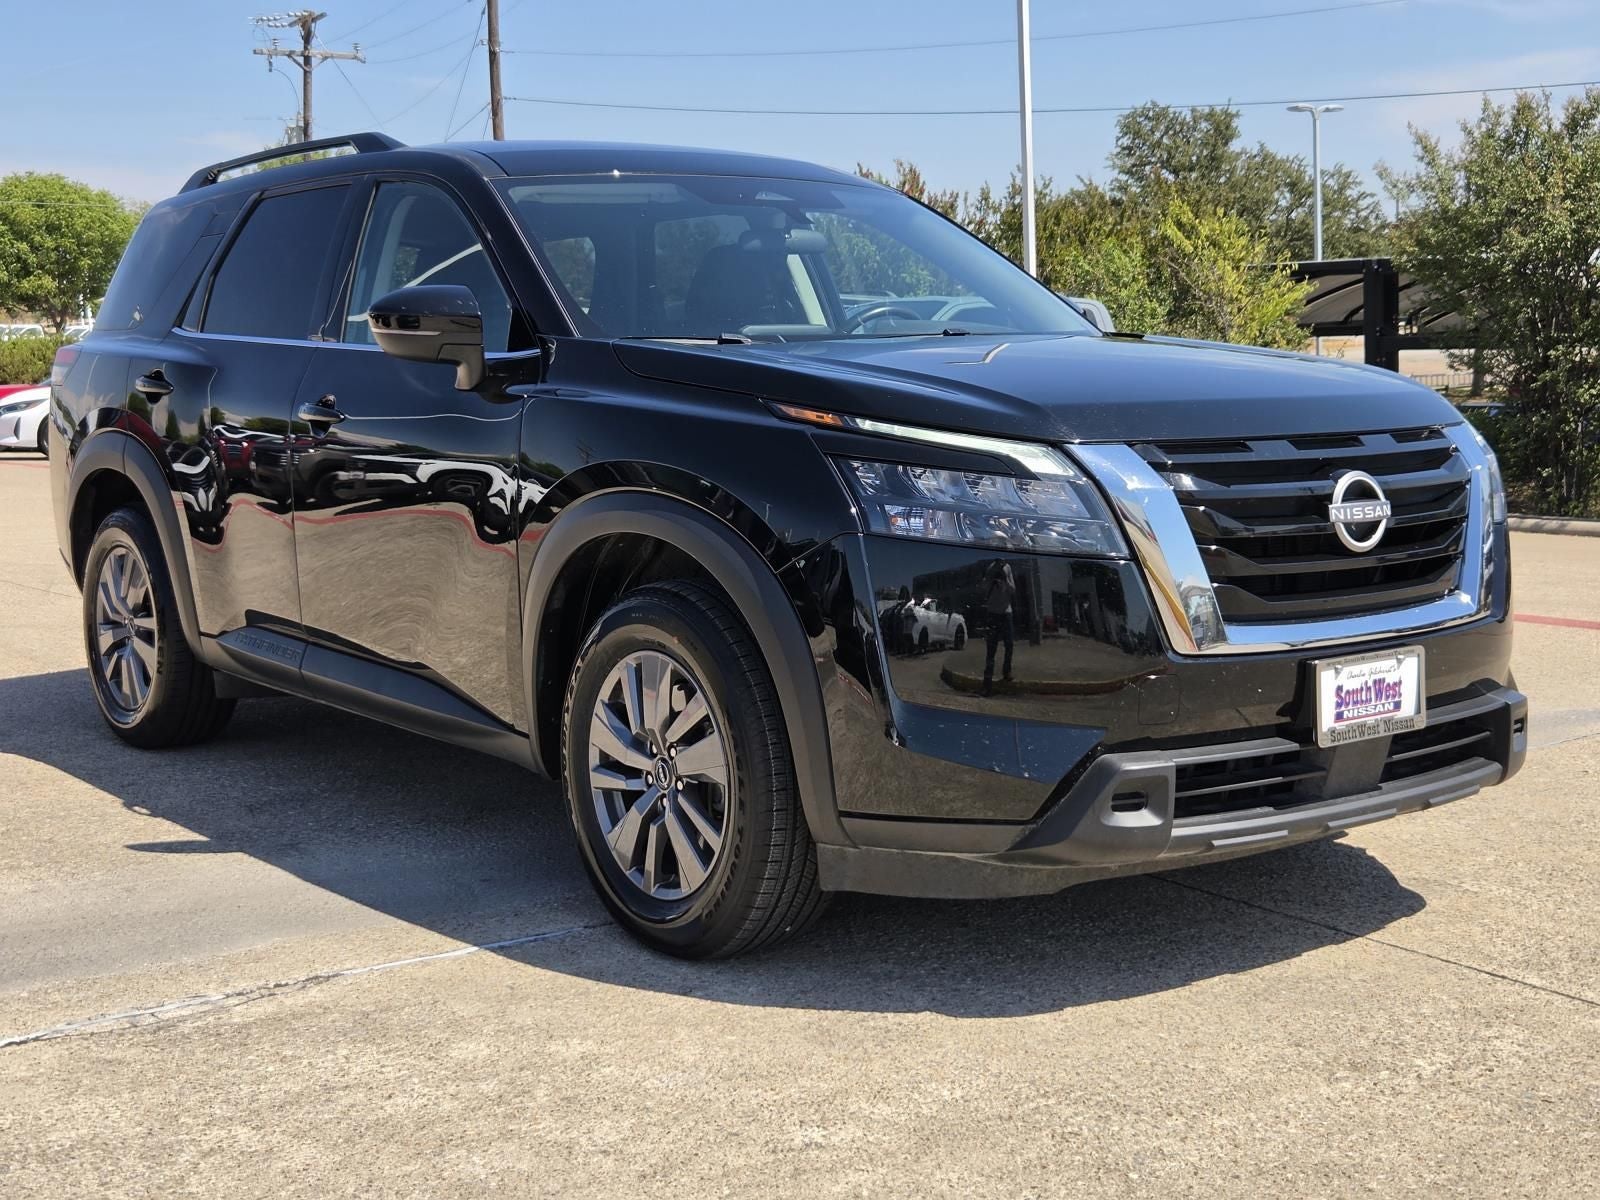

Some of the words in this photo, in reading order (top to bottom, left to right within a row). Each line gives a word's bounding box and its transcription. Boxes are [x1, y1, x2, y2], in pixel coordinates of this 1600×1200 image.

[1331, 505, 1391, 519] NISSAN
[1343, 703, 1394, 719] NISSAN
[1384, 718, 1416, 733] Nissan
